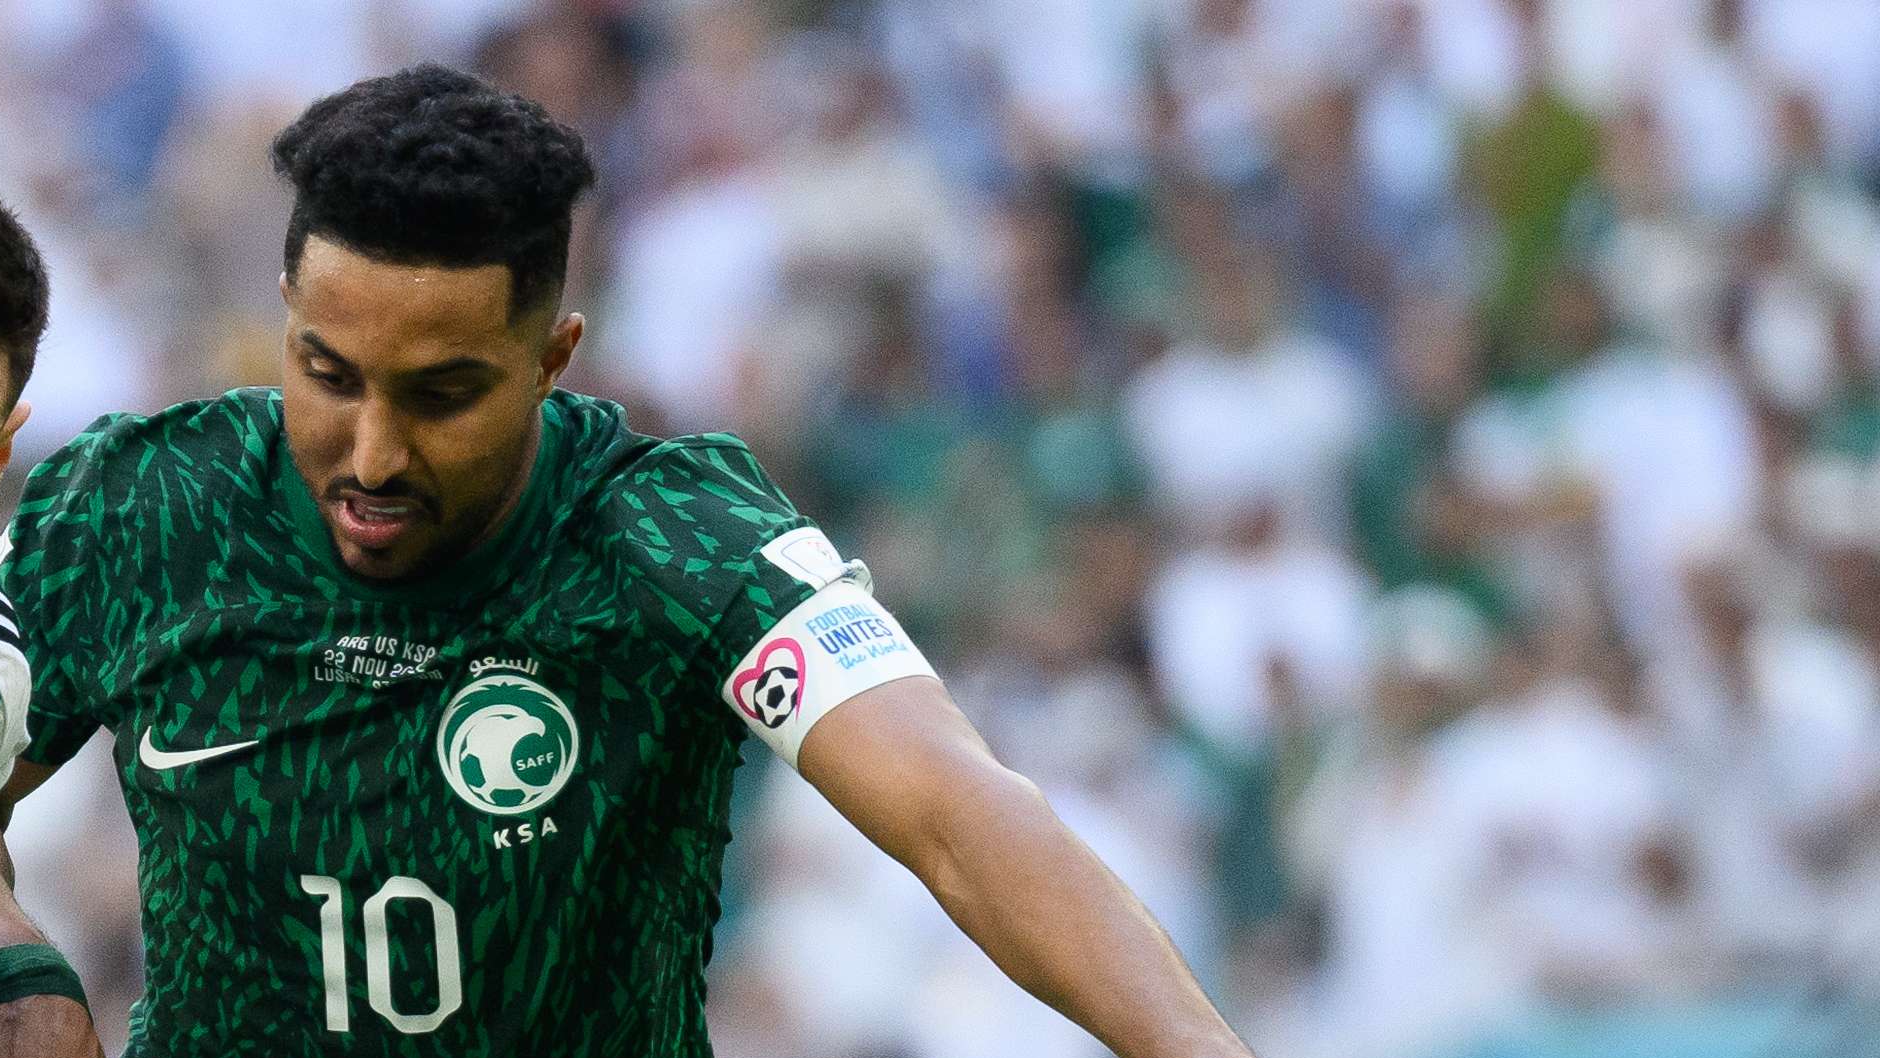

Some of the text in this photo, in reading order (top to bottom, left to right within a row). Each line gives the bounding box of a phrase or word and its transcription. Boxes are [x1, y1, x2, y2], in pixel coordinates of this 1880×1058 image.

[336, 635, 371, 651] ARG
[817, 617, 894, 655] UNITES
[324, 649, 346, 670] 22
[516, 752, 554, 771] SAFF
[493, 816, 558, 850] KSA
[300, 874, 462, 1034] 10
